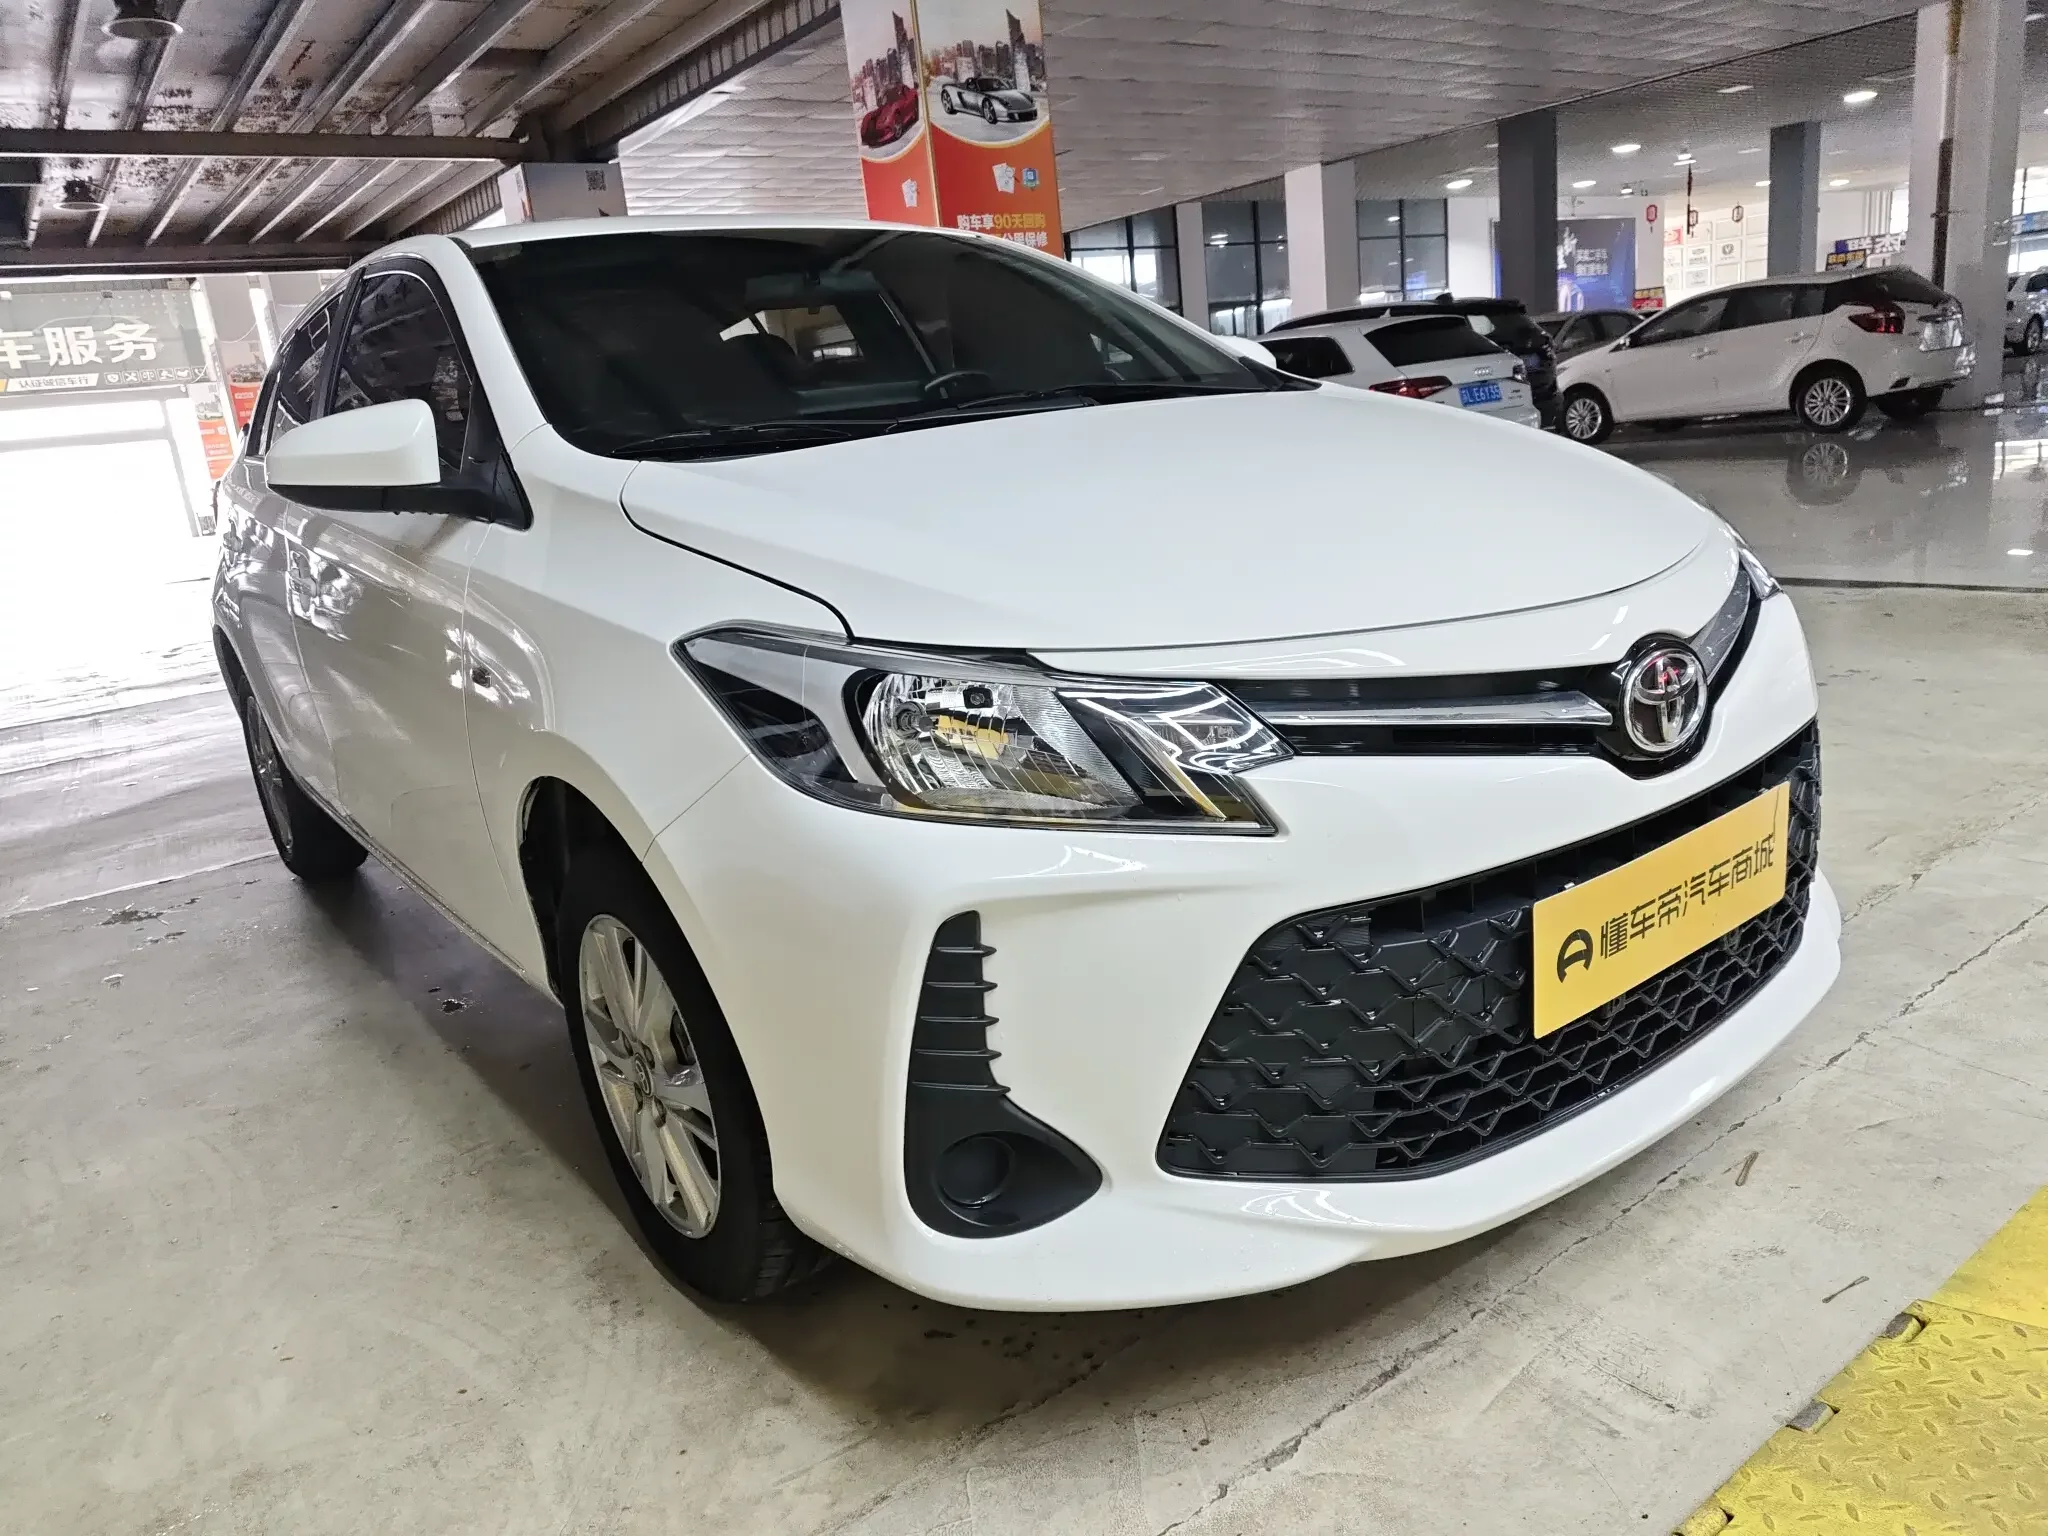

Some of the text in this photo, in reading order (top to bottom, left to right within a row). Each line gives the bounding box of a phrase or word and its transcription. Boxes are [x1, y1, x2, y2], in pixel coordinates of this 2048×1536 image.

[958, 213, 1045, 231] 购车享90天回购
[993, 232, 1048, 247] 公里保修
[1600, 832, 1775, 959] 懂车帝汽车商城
